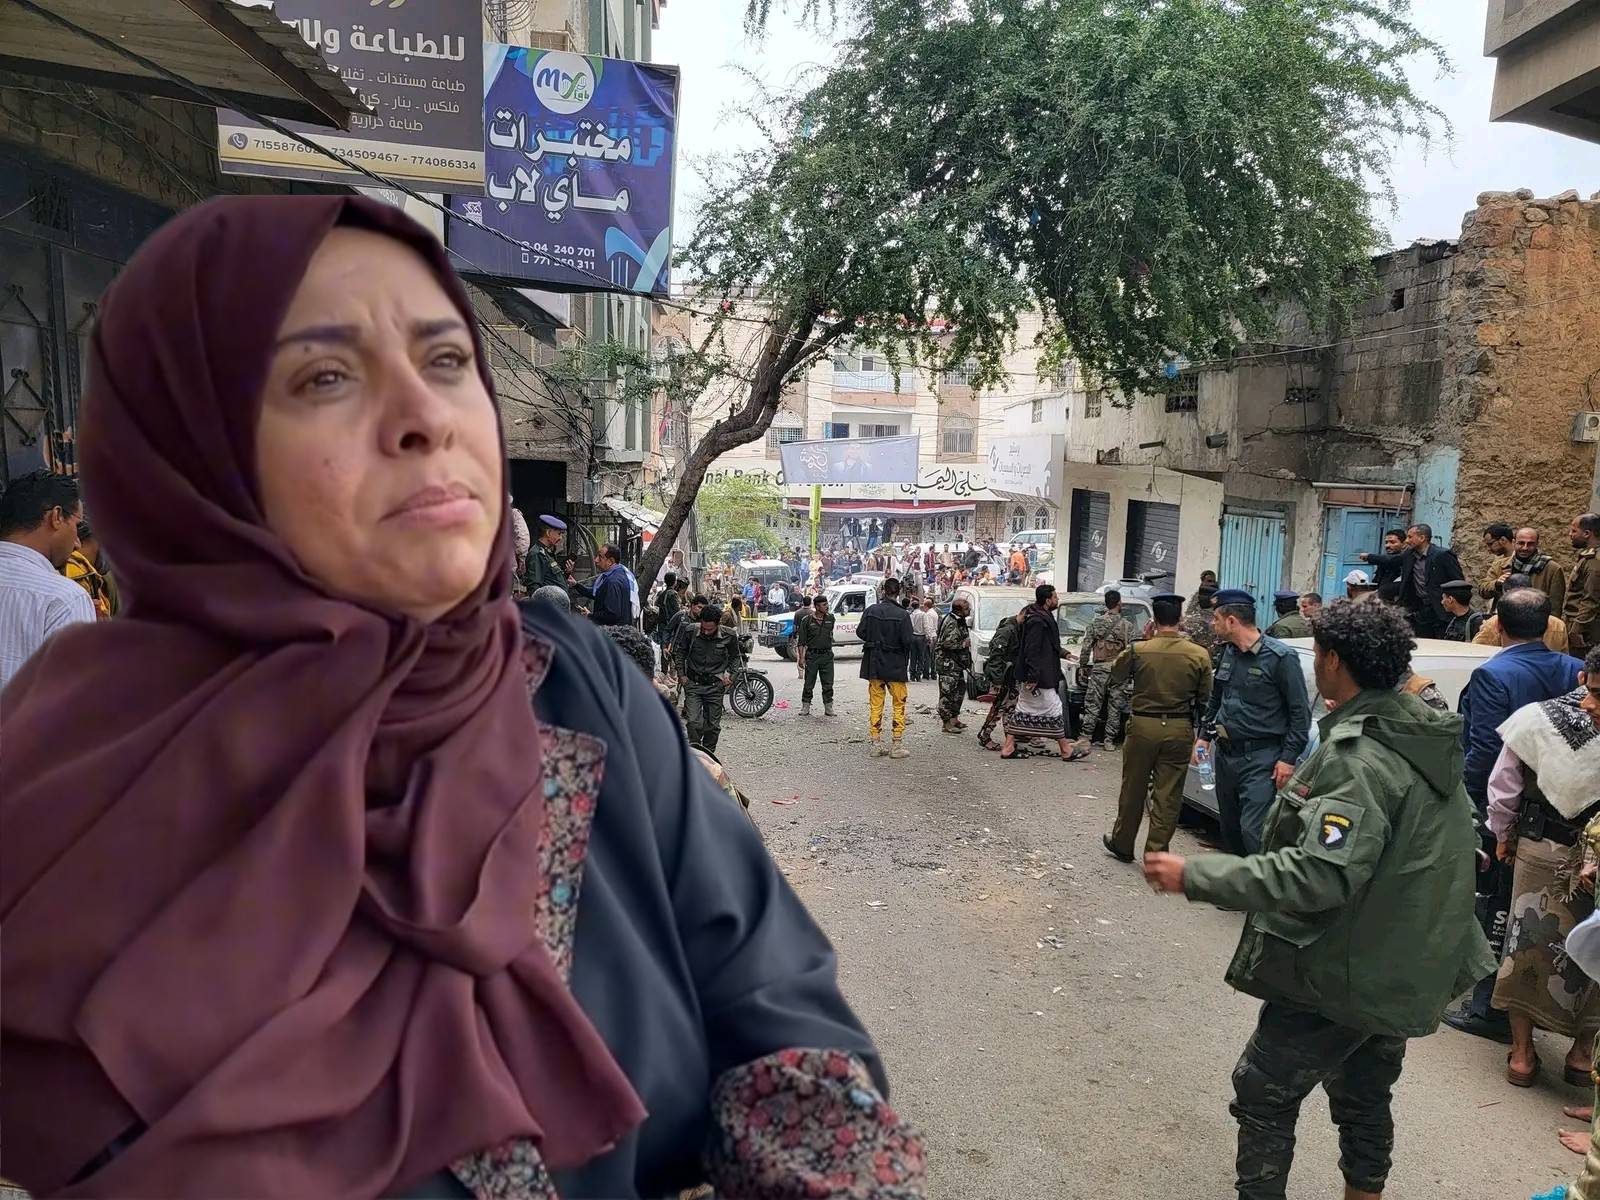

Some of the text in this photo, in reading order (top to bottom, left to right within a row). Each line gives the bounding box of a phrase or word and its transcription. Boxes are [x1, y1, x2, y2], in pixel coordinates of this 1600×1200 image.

[350, 24, 465, 62] للطباعة
[376, 71, 427, 90] مستندات
[431, 75, 466, 95] طباعة
[423, 100, 461, 114] فلكس
[351, 113, 424, 132] طباعة حرارية
[488, 110, 632, 167] مختبرات
[331, 147, 400, 163] 734509467
[410, 154, 477, 171] 774086334
[533, 242, 595, 258] 04 240 701
[577, 259, 595, 271] 311
